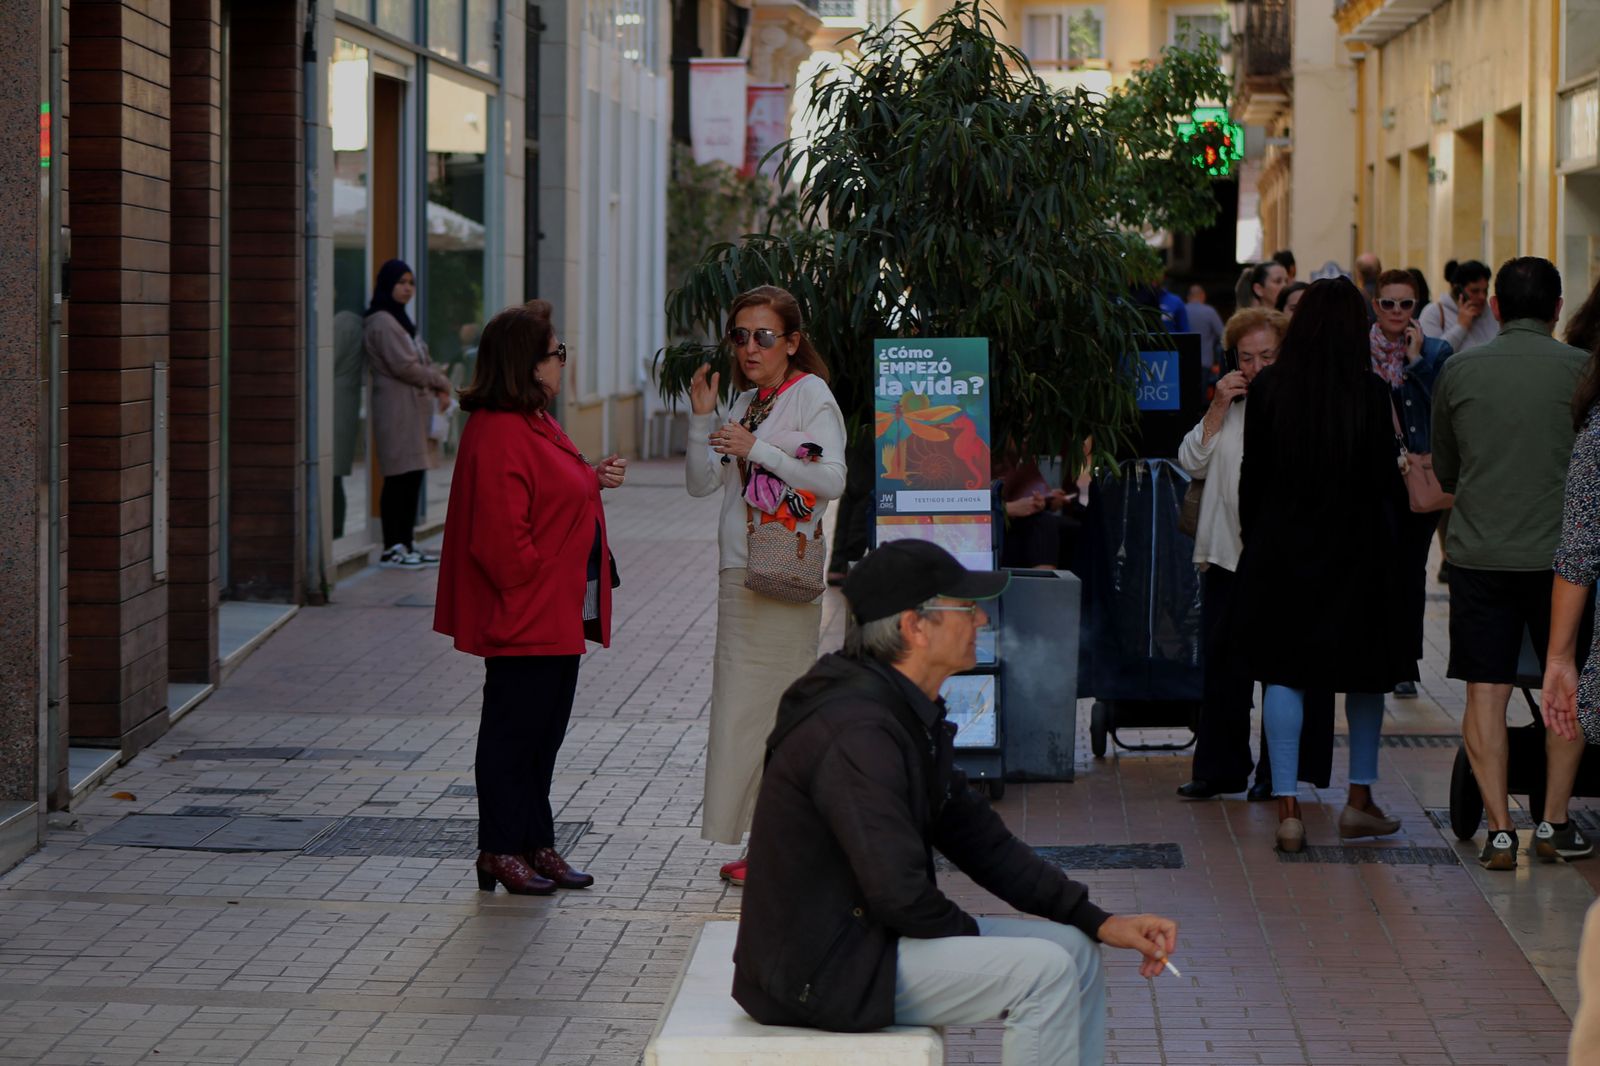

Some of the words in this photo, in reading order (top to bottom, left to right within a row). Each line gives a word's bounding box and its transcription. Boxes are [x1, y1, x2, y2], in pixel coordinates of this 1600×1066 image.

[879, 346, 933, 361] ¿Cómo
[879, 357, 952, 375] EMPEZÓ
[879, 376, 903, 396] la
[911, 376, 984, 396] vida?
[880, 494, 893, 502] JW
